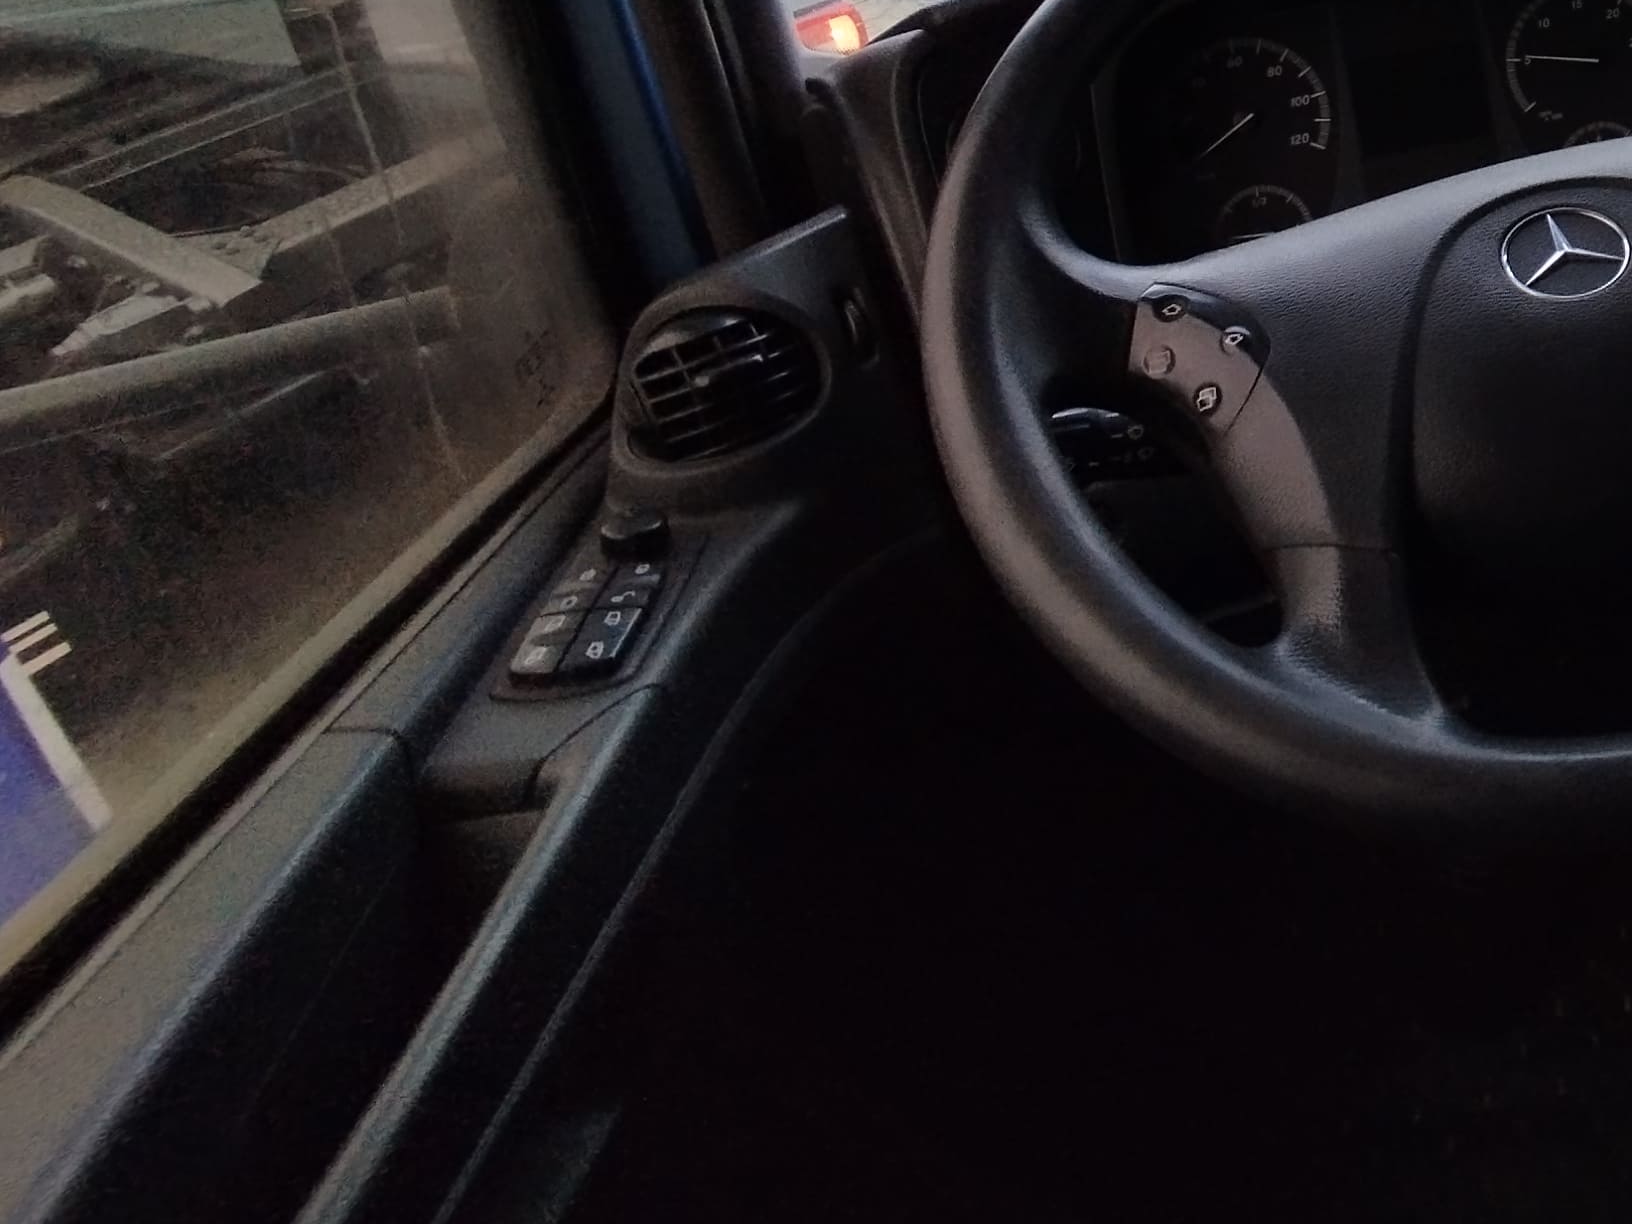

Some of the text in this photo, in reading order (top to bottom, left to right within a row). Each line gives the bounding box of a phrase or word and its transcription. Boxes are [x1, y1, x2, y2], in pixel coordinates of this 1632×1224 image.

[1570, 0, 1583, 11] 15
[1605, 7, 1620, 20] 20
[1537, 17, 1550, 29] 10
[1266, 65, 1283, 78] 80
[1290, 94, 1310, 107] 100
[1289, 133, 1310, 145] 120
